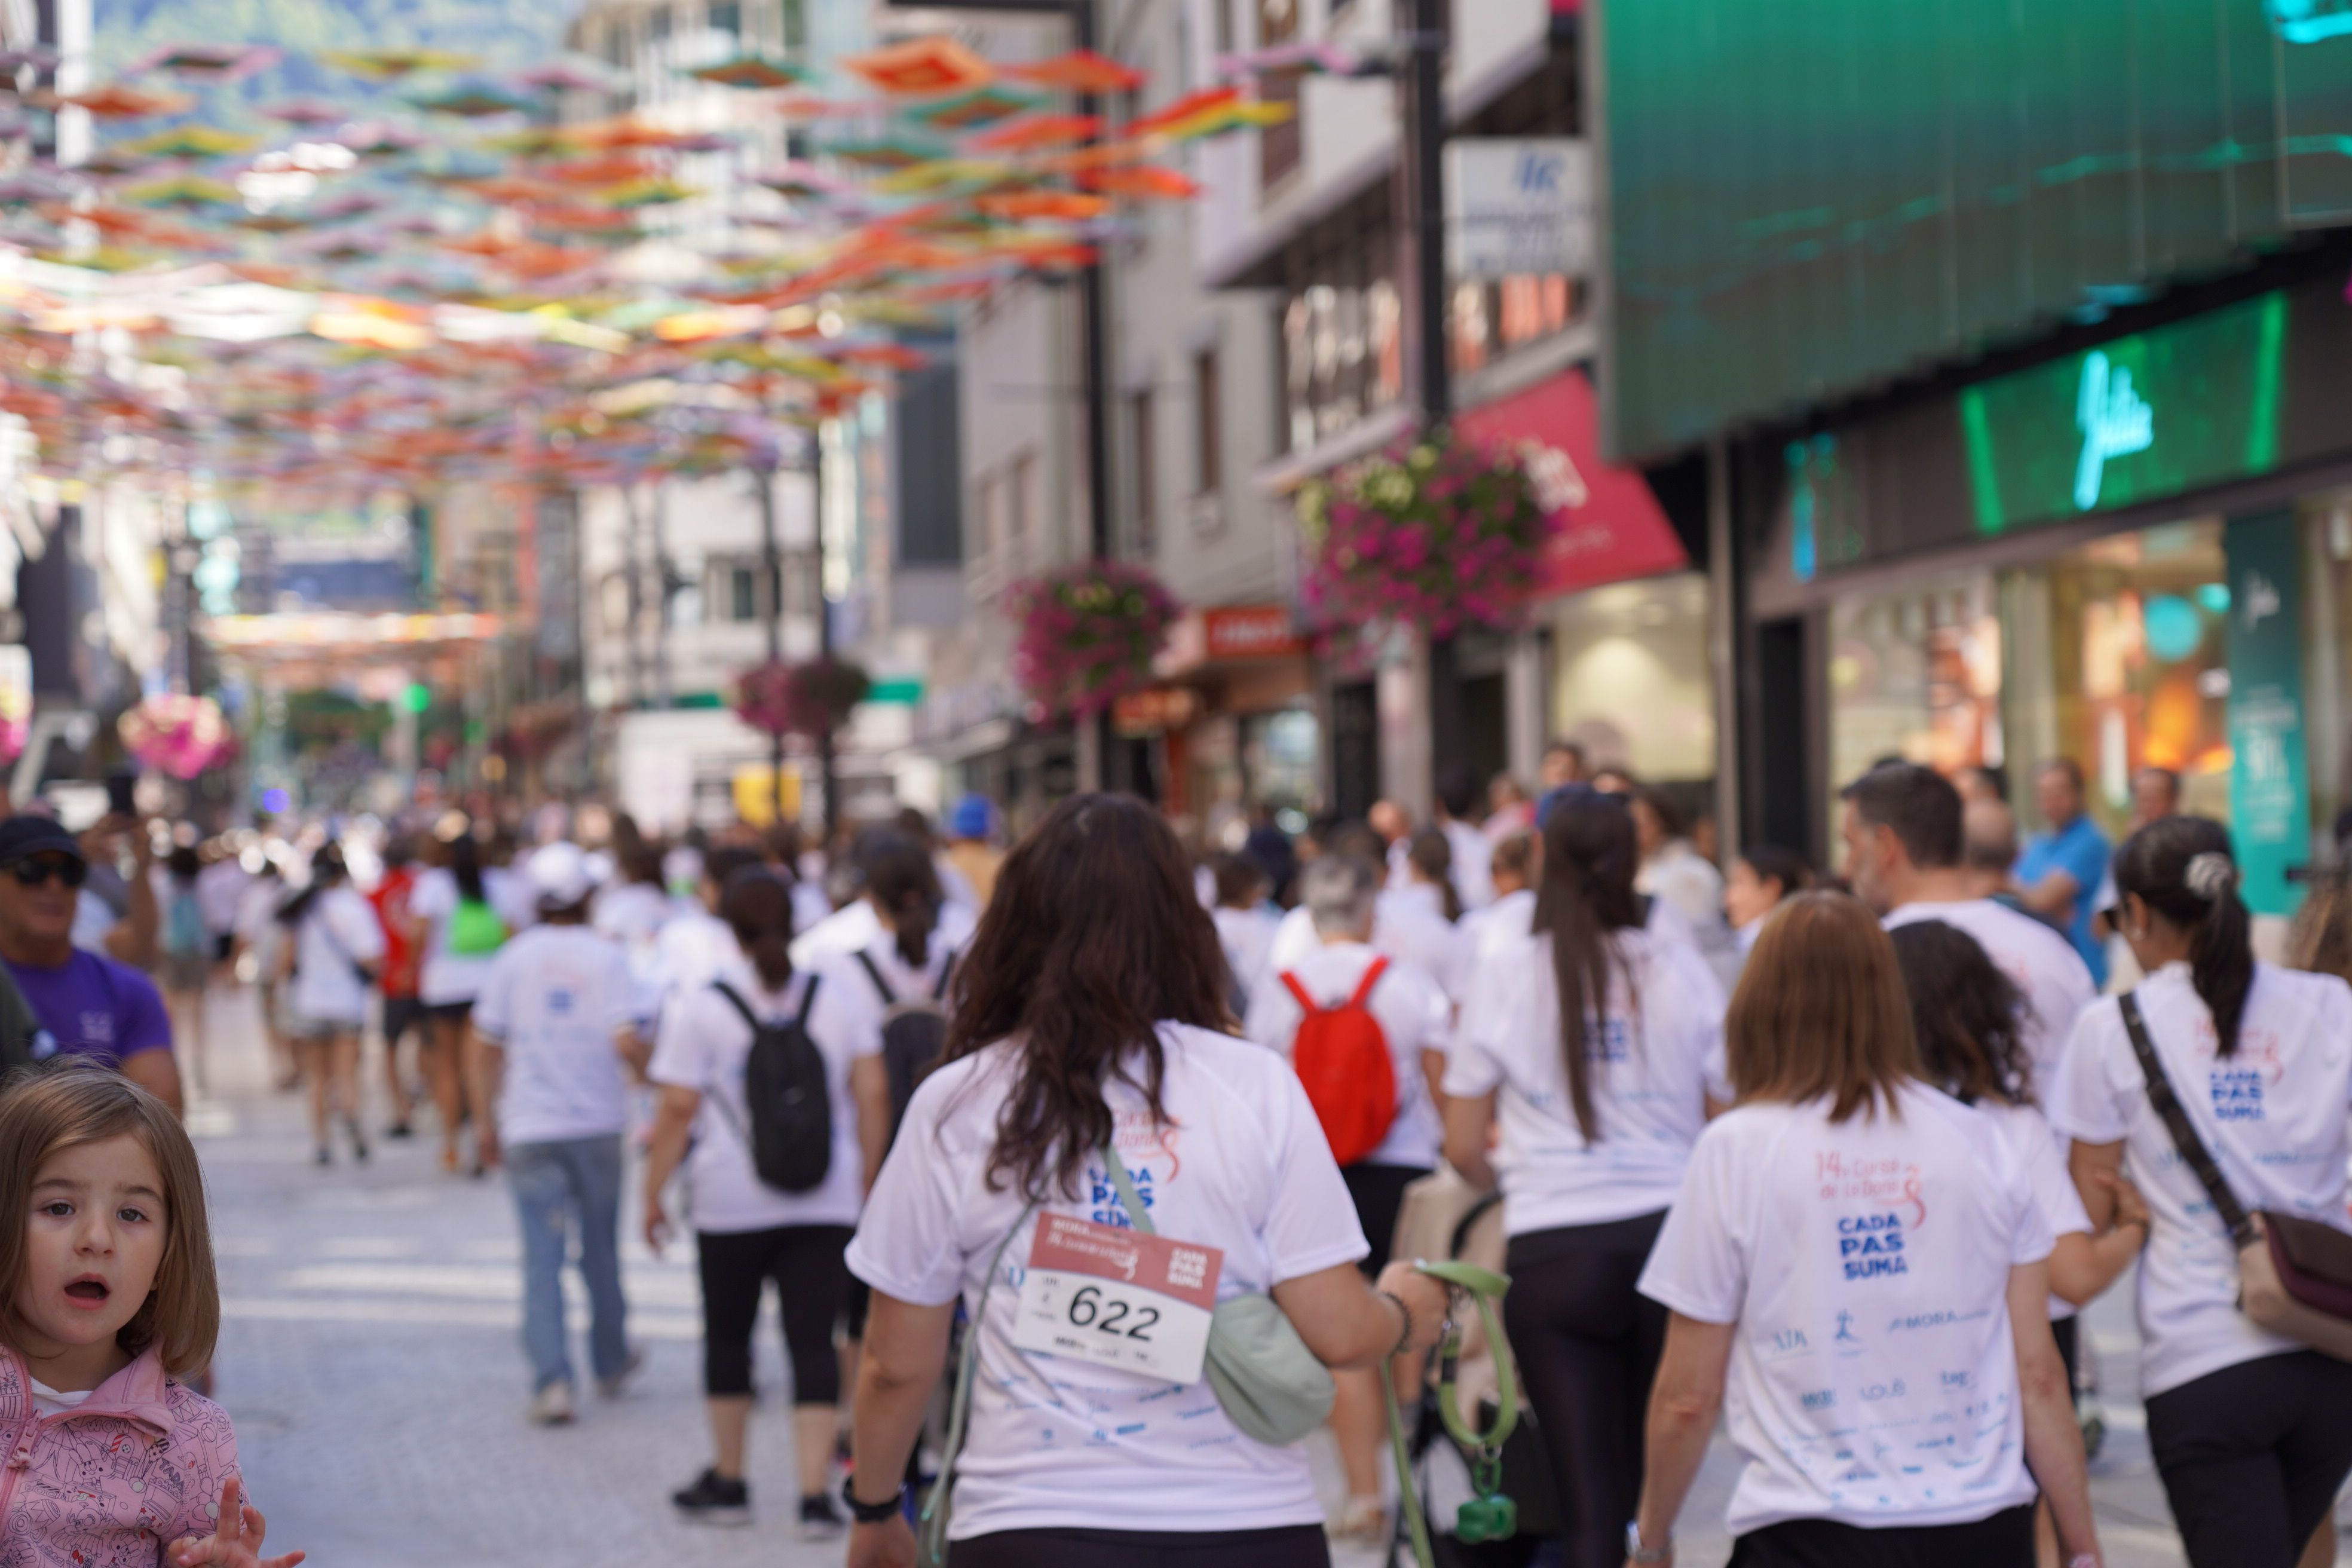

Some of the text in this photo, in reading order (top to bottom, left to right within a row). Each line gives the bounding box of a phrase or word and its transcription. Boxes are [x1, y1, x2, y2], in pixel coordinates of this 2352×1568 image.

[1838, 1214, 1903, 1233] CADA
[1840, 1233, 1905, 1257] PAS
[1844, 1256, 1909, 1280] SUMA
[1070, 1286, 1159, 1342] 622
[85, 1417, 130, 1435] WOW
